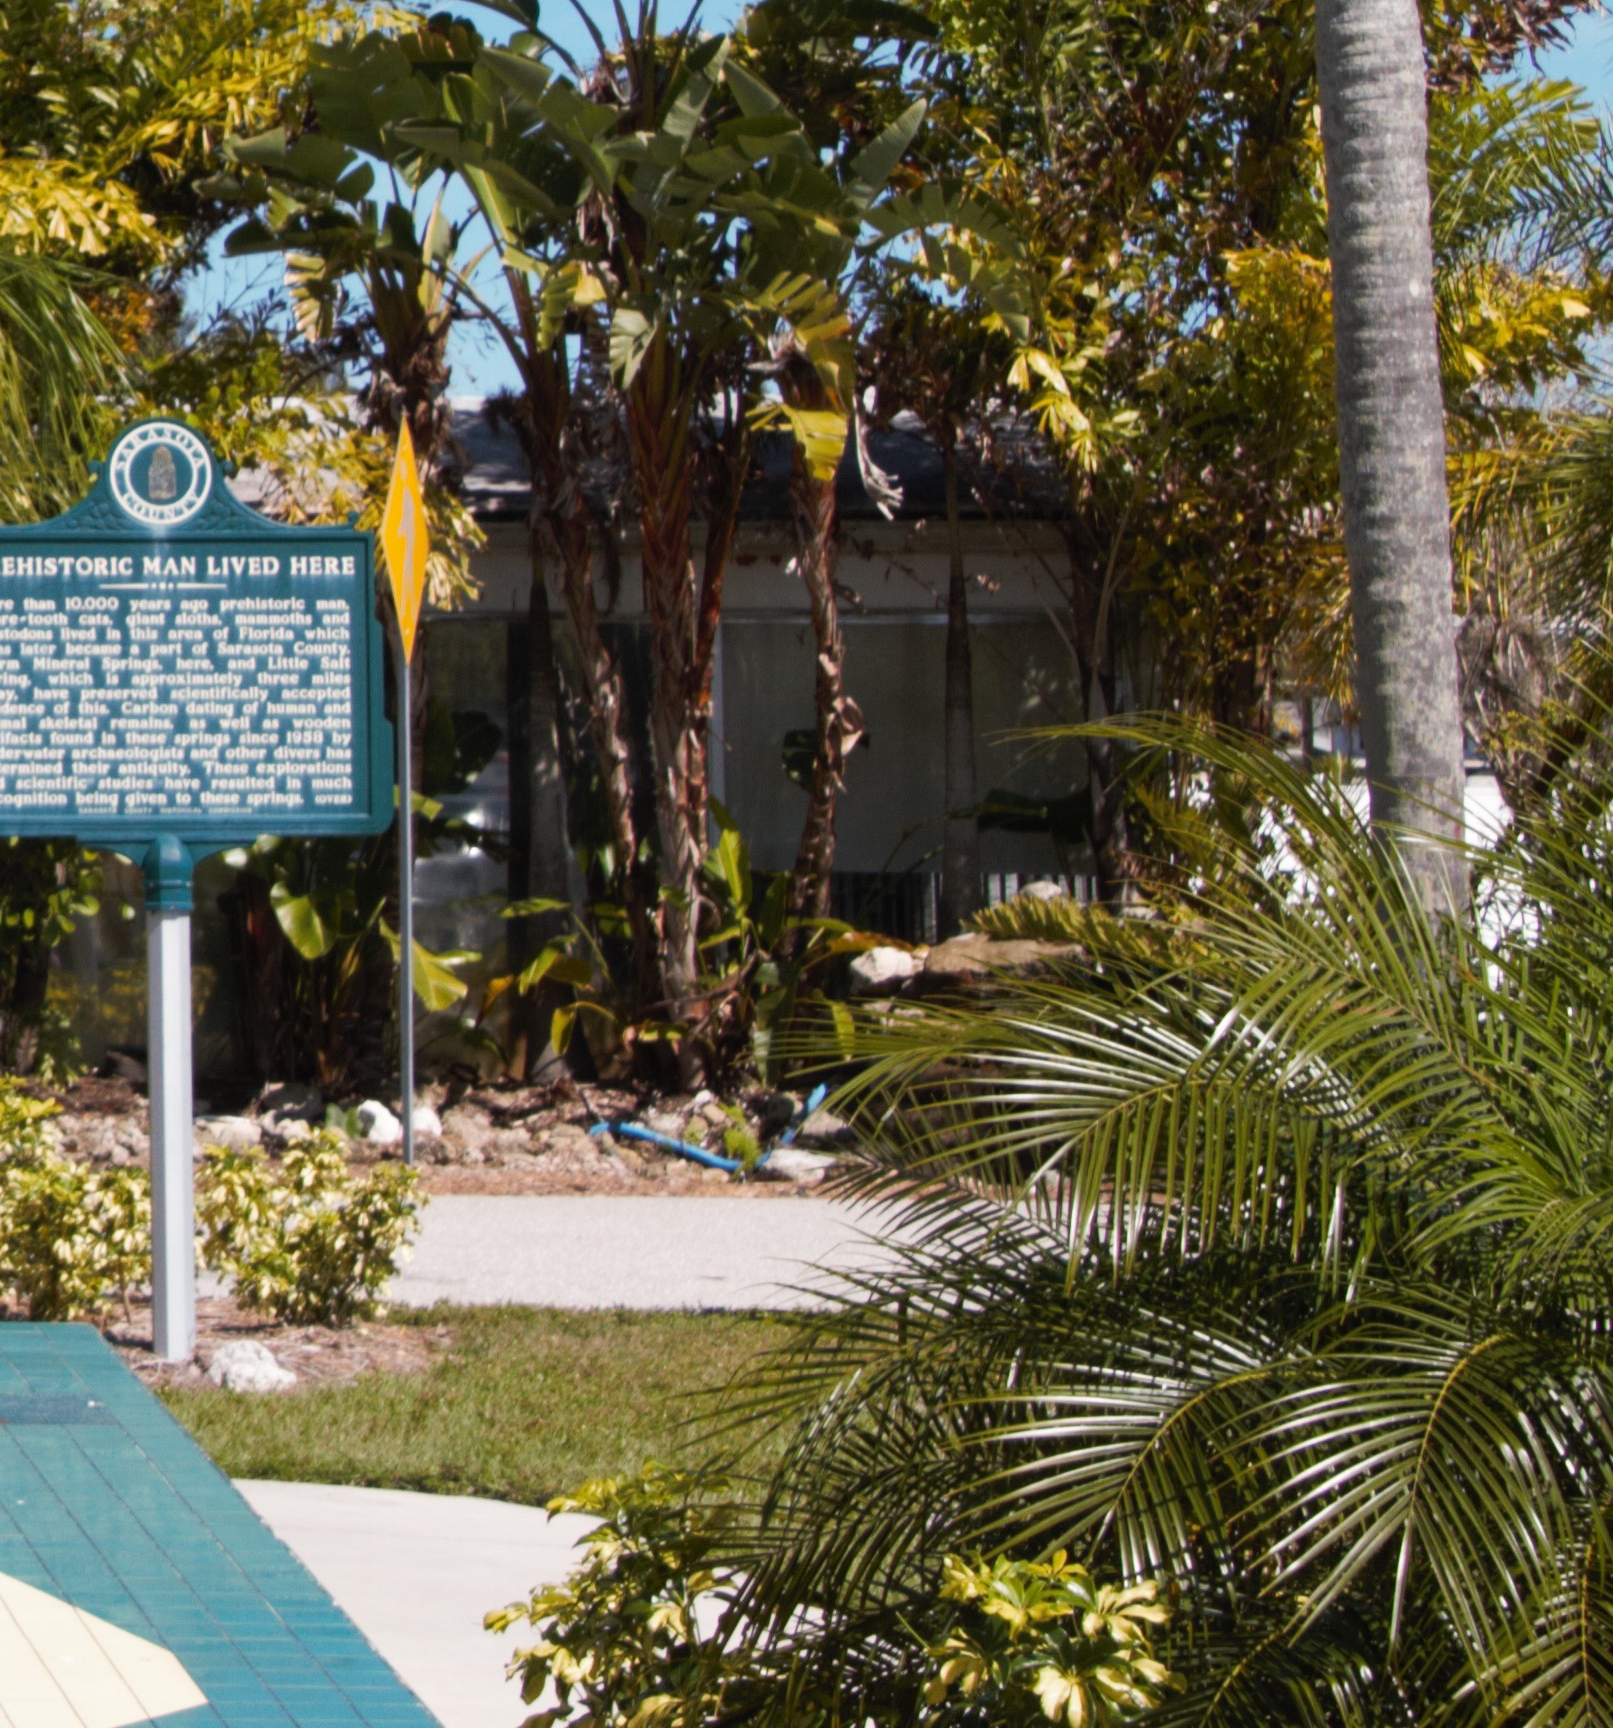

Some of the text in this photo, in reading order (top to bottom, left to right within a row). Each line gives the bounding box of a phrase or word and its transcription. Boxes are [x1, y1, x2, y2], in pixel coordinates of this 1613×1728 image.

[115, 427, 206, 471] SARASOTA
[120, 491, 201, 520] COUNTY
[142, 556, 197, 577] MAN
[206, 556, 280, 577] LIVED
[289, 556, 356, 577] HERE
[23, 597, 56, 611] than
[129, 599, 172, 613] years
[180, 599, 209, 613] ago
[219, 597, 305, 613] prehistoric
[125, 612, 166, 627] giant
[234, 612, 313, 625] mammoths
[322, 612, 351, 625] and
[60, 626, 97, 640] lived
[106, 626, 122, 640] in
[129, 626, 159, 640] this
[168, 628, 204, 640] area
[213, 626, 229, 640] of
[239, 626, 295, 640] Florida
[304, 626, 350, 640] which
[20, 641, 57, 655] later
[65, 641, 122, 655] became
[129, 643, 140, 655] a
[150, 641, 183, 657] part
[191, 641, 209, 655] of
[217, 641, 284, 655] Sarasota
[33, 656, 91, 671] Mineral
[227, 656, 257, 671] and
[268, 656, 309, 671] Little
[320, 656, 351, 671] Salt
[48, 672, 94, 685] which
[106, 672, 120, 685] is
[131, 672, 243, 687] approximately
[257, 672, 300, 685] three
[311, 672, 351, 685] miles
[33, 686, 69, 700] have
[80, 686, 158, 702] preserved
[170, 686, 269, 702] scientifically
[281, 686, 352, 702] accepted
[53, 701, 70, 715] of
[121, 701, 178, 715] Carbon
[185, 701, 235, 717] dating
[242, 701, 259, 715] of
[266, 701, 317, 715] human
[323, 701, 352, 715] and
[38, 716, 98, 729] skeletal
[189, 718, 207, 729] as
[219, 716, 251, 729] well
[262, 718, 280, 729] as
[292, 716, 352, 729] wooden
[50, 730, 94, 745] found
[101, 730, 117, 745] in
[125, 730, 167, 745] these
[174, 730, 231, 747] springs
[239, 730, 279, 745] since
[286, 730, 324, 745] 1958
[332, 730, 352, 747] by
[71, 746, 185, 762] archaeologists
[190, 746, 219, 760] and
[225, 746, 267, 760] other
[273, 746, 321, 760] divers
[326, 746, 352, 760] has
[72, 761, 111, 775] their
[203, 761, 249, 775] These
[256, 761, 352, 777] explorations
[15, 776, 89, 790] scientific
[98, 776, 154, 790] studies
[164, 776, 201, 790] have
[211, 776, 276, 790] resulted
[286, 776, 302, 790] in
[311, 776, 353, 790] much
[75, 791, 119, 807] being
[125, 791, 168, 807] given
[175, 791, 192, 805] to
[199, 791, 240, 805] these
